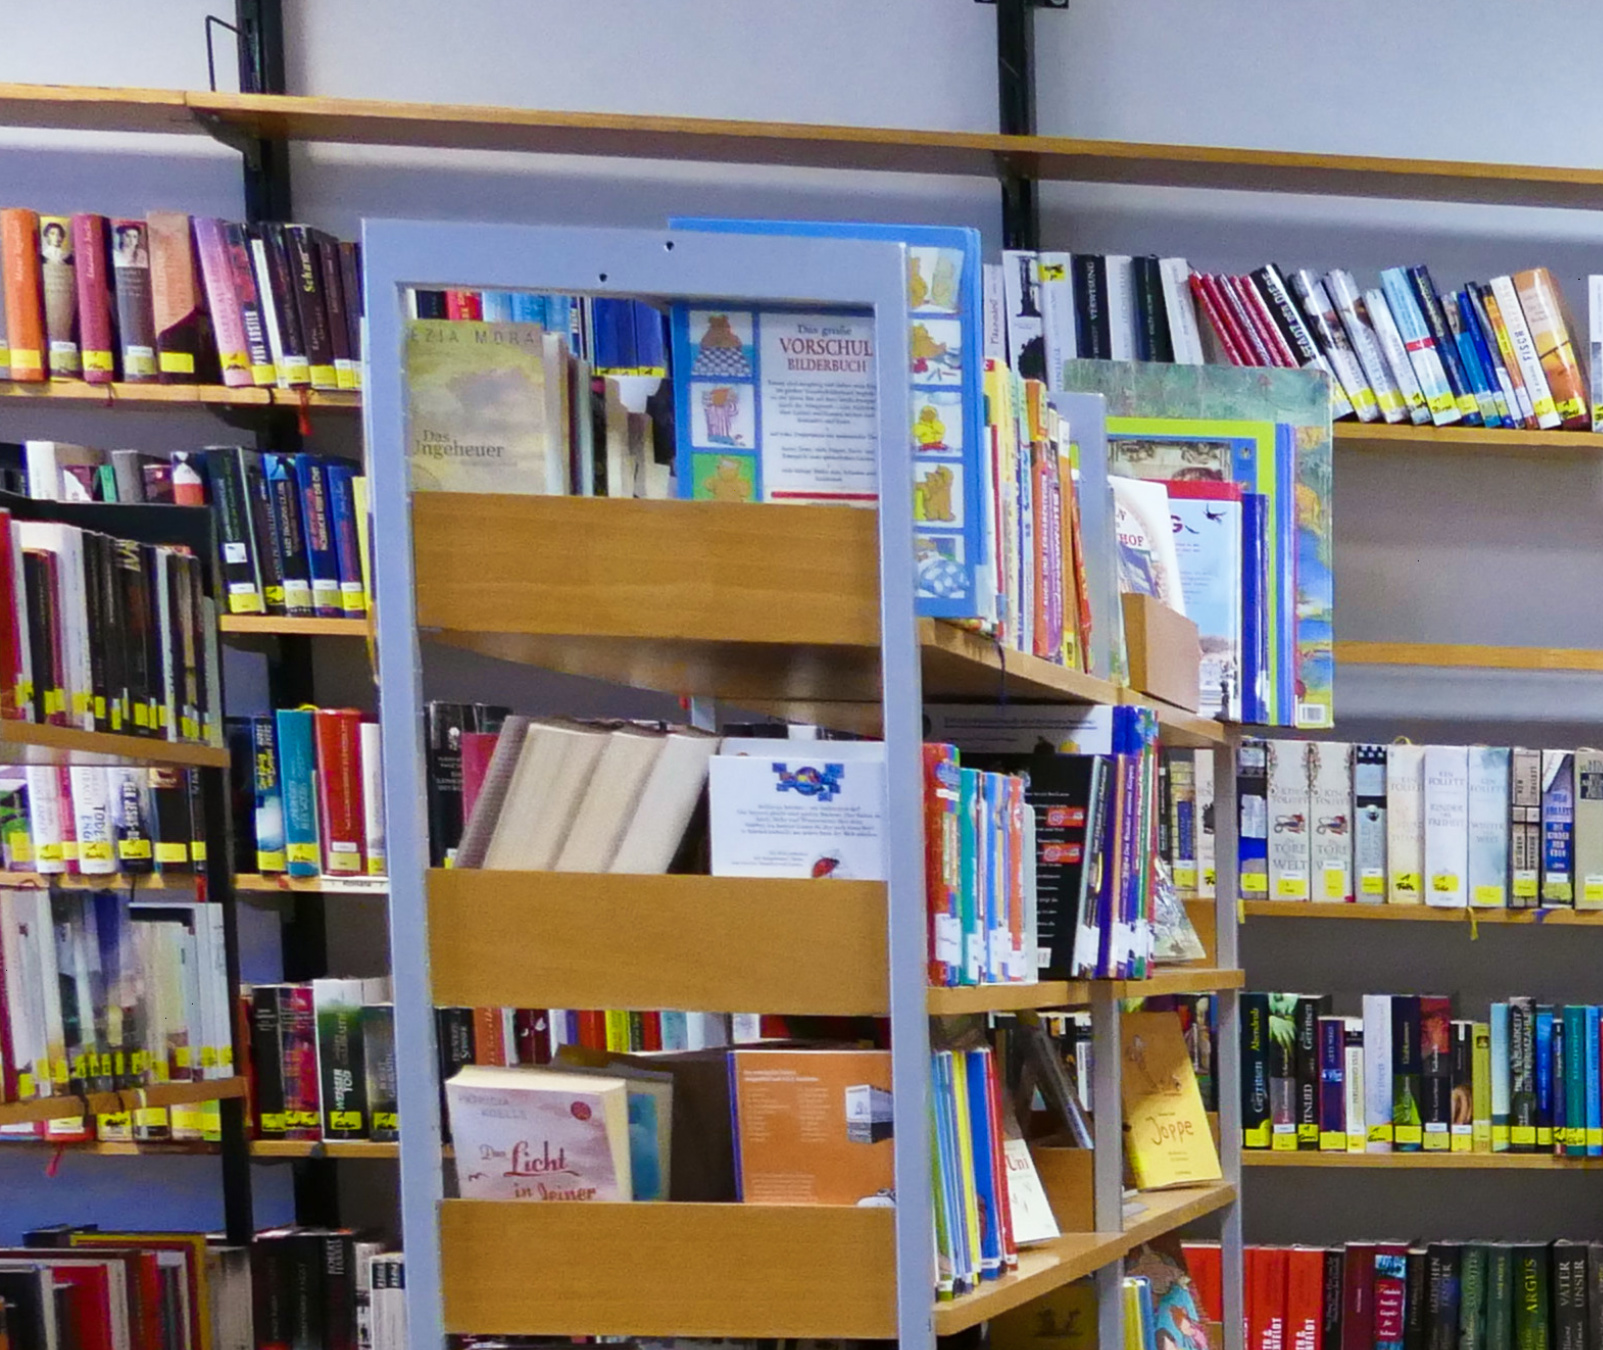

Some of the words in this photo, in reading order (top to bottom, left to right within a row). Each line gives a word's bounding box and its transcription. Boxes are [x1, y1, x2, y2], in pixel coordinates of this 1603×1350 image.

[787, 357, 867, 374] BILDERBUCH
[423, 430, 450, 442] Das
[1146, 1117, 1194, 1146] Joppe
[504, 1141, 580, 1177] Licht
